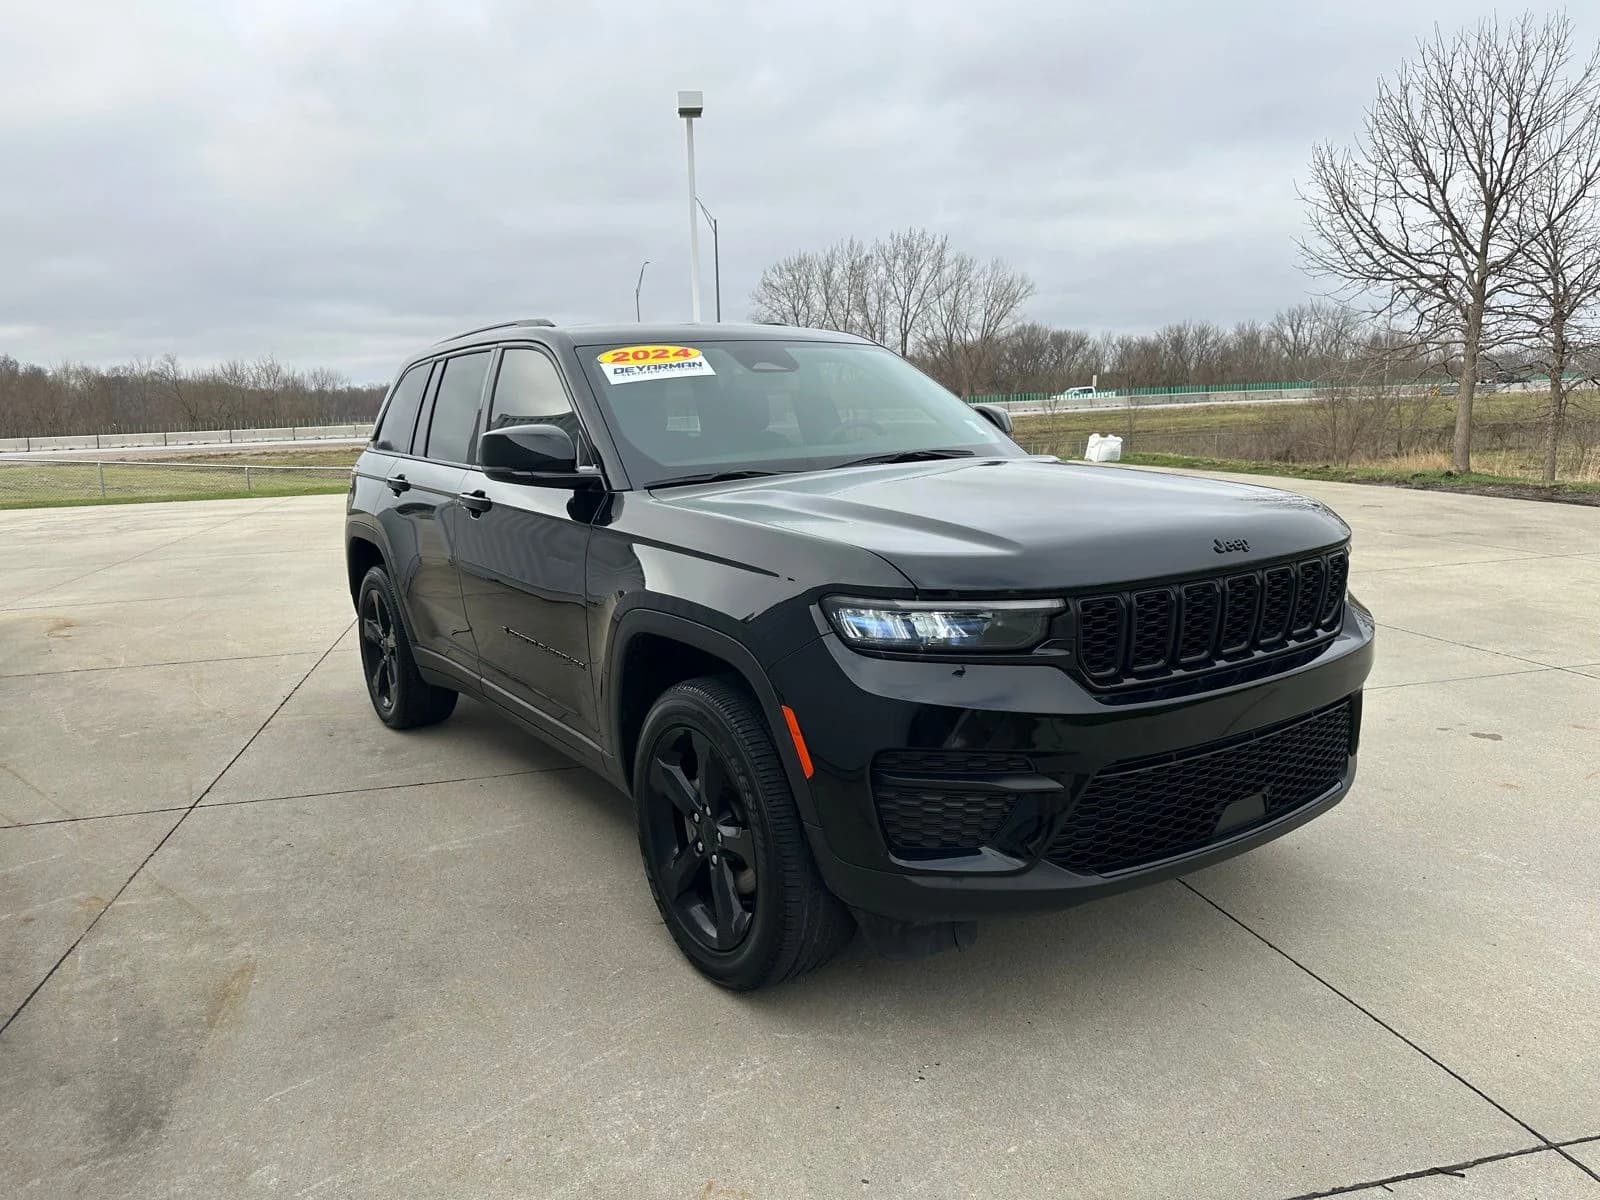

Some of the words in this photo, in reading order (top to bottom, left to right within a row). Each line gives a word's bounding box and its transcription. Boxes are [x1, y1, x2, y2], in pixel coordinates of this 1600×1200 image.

[611, 349, 691, 362] 2024
[613, 361, 703, 375] DEYARMAN
[1213, 538, 1250, 554] Jeep
